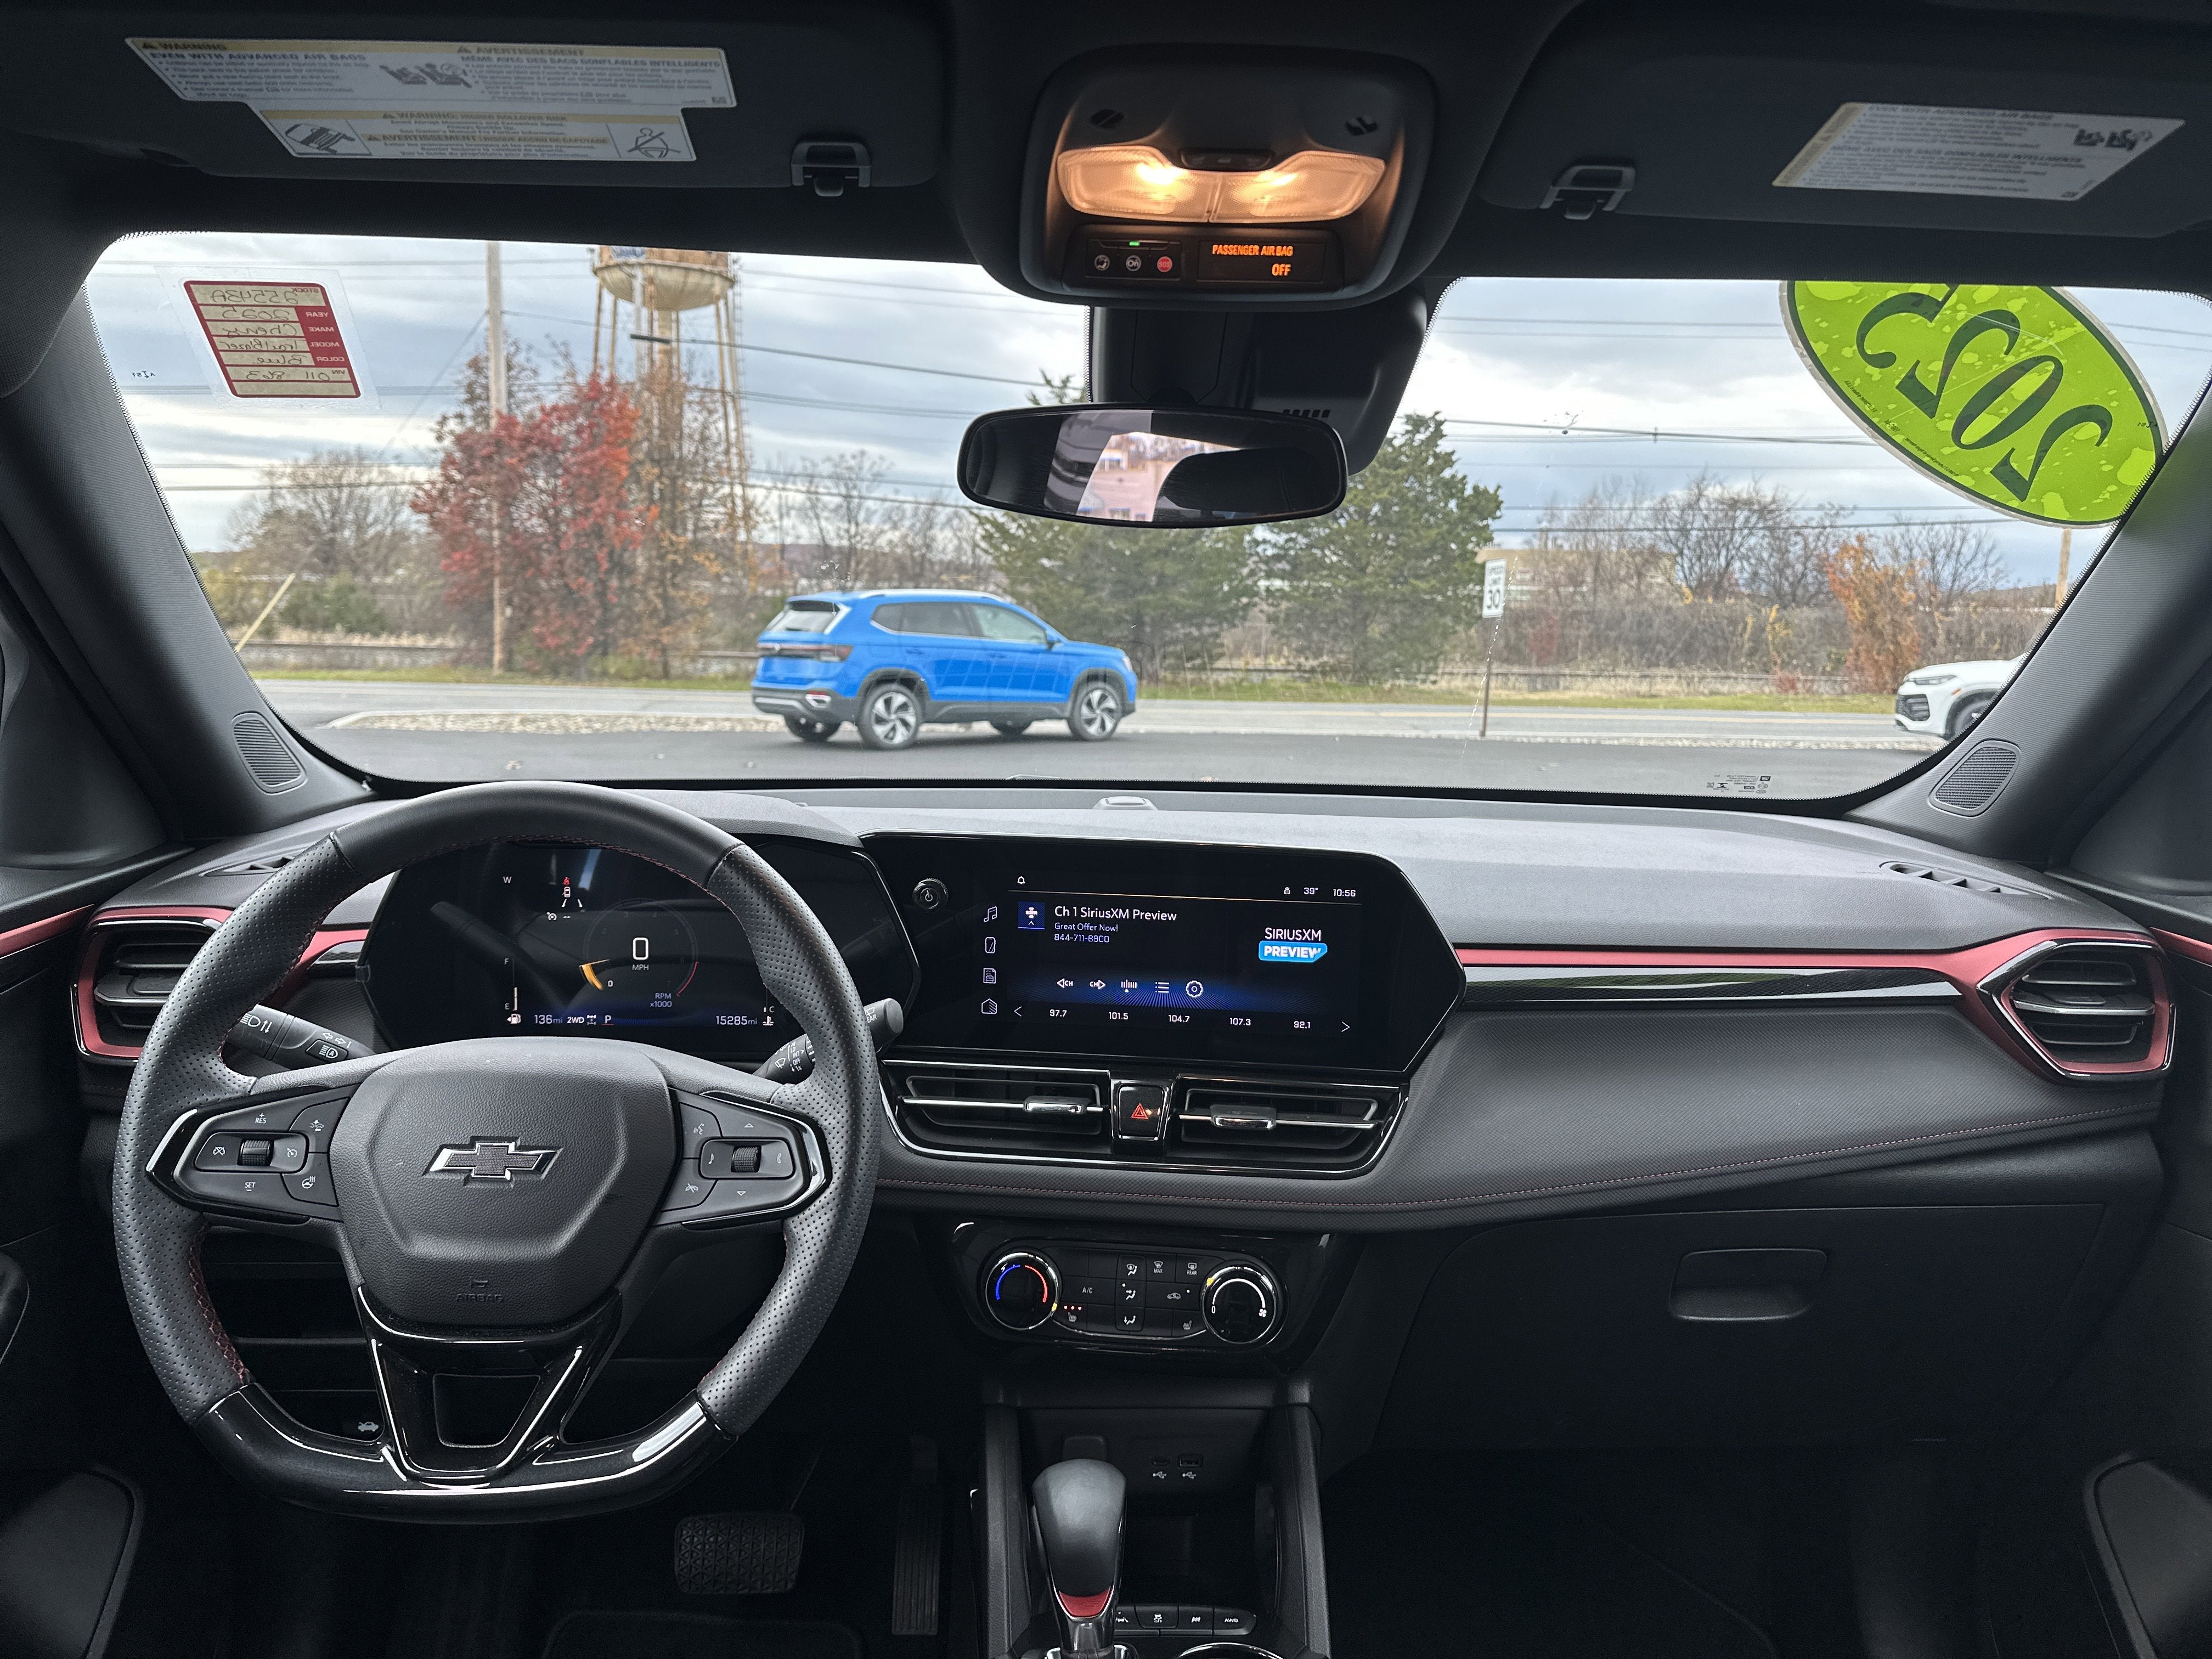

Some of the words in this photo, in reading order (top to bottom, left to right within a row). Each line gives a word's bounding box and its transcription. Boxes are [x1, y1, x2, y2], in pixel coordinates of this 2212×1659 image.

[1211, 244, 1260, 256] PASSENGER
[1261, 245, 1274, 256] AIR
[1276, 246, 1294, 256] BAG
[1271, 263, 1291, 276] OFF
[1486, 589, 1500, 609] 30
[503, 876, 512, 884] W
[1304, 887, 1319, 895] 39°
[1333, 889, 1356, 897] 10:56
[1054, 906, 1070, 917] Ch
[1073, 907, 1077, 917] 1
[1080, 907, 1129, 920] SiriusXM
[1132, 909, 1177, 921] Preview
[1054, 922, 1076, 930] Great
[1077, 923, 1097, 931] Offer
[1099, 924, 1119, 932] Now!
[1054, 934, 1110, 943] 844-711-8800
[1265, 927, 1322, 941] SIRIUSXM
[633, 937, 649, 961] 0
[1263, 945, 1322, 958] PREVIEW
[605, 1015, 612, 1023] P
[1049, 1009, 1068, 1017] 97.7
[1108, 1012, 1128, 1020] 101.5
[1168, 1014, 1190, 1023] 104.7
[1229, 1018, 1251, 1026] 107.3
[1293, 1020, 1311, 1029] 92.1
[792, 1057, 801, 1066] OFF
